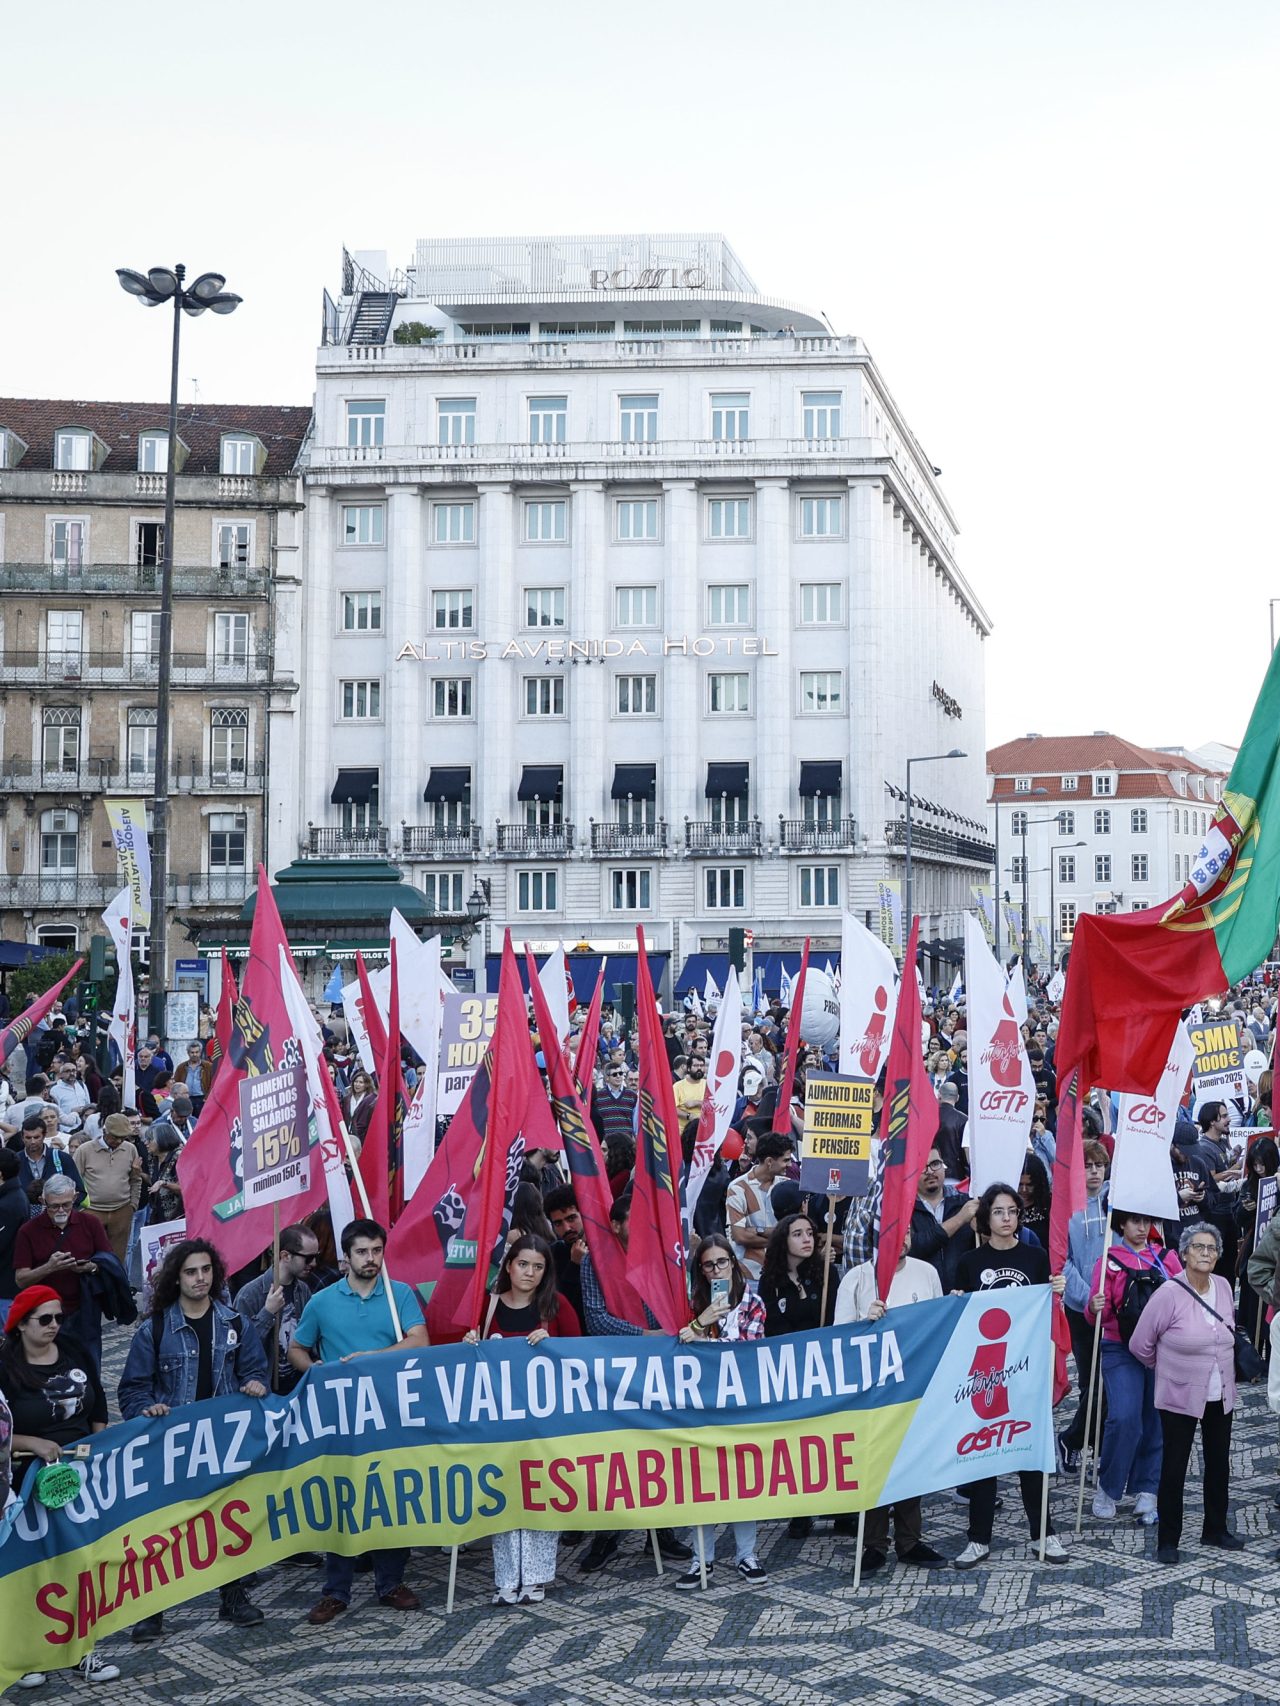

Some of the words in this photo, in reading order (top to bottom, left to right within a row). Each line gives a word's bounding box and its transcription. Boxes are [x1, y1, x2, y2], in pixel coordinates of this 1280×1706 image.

[396, 640, 488, 661] ALTIS
[500, 639, 649, 659] AVENIDA
[662, 635, 780, 656] HOTEL
[618, 941, 631, 950] Bar
[1190, 1024, 1239, 1056] SMN
[1195, 1050, 1240, 1073] 1000€
[251, 1071, 294, 1100] AUMENTO
[1198, 1075, 1225, 1089] Janeiro
[1224, 1071, 1243, 1084] 2025
[250, 1095, 278, 1118] GERAL
[279, 1086, 298, 1108] DOS
[807, 1084, 851, 1102] AUMENTO
[852, 1087, 871, 1103] DAS
[980, 1090, 1029, 1113] CGTP
[252, 1104, 297, 1133] SALÁRIOS
[813, 1111, 862, 1129] REFORMAS
[252, 1121, 300, 1171] 15%
[812, 1138, 818, 1154] E
[819, 1137, 860, 1155] PENSÕES
[994, 1269, 1025, 1282] ELÂMPAGO
[64, 1434, 150, 1524] QUE
[163, 1410, 252, 1486] FAZ
[265, 1374, 389, 1458] FALTA
[397, 1356, 426, 1428] É
[433, 1354, 701, 1423] VALORIZAR
[716, 1351, 747, 1409] A
[758, 1330, 905, 1401] MALTA
[956, 1420, 1032, 1456] CGTP
[955, 1448, 1000, 1465] Intersindical
[1001, 1444, 1033, 1455] Nacional
[35, 1499, 253, 1645] SALÁRIOS
[267, 1461, 505, 1541] HORÁRIOS
[520, 1433, 860, 1512] ESTABILIDADE
